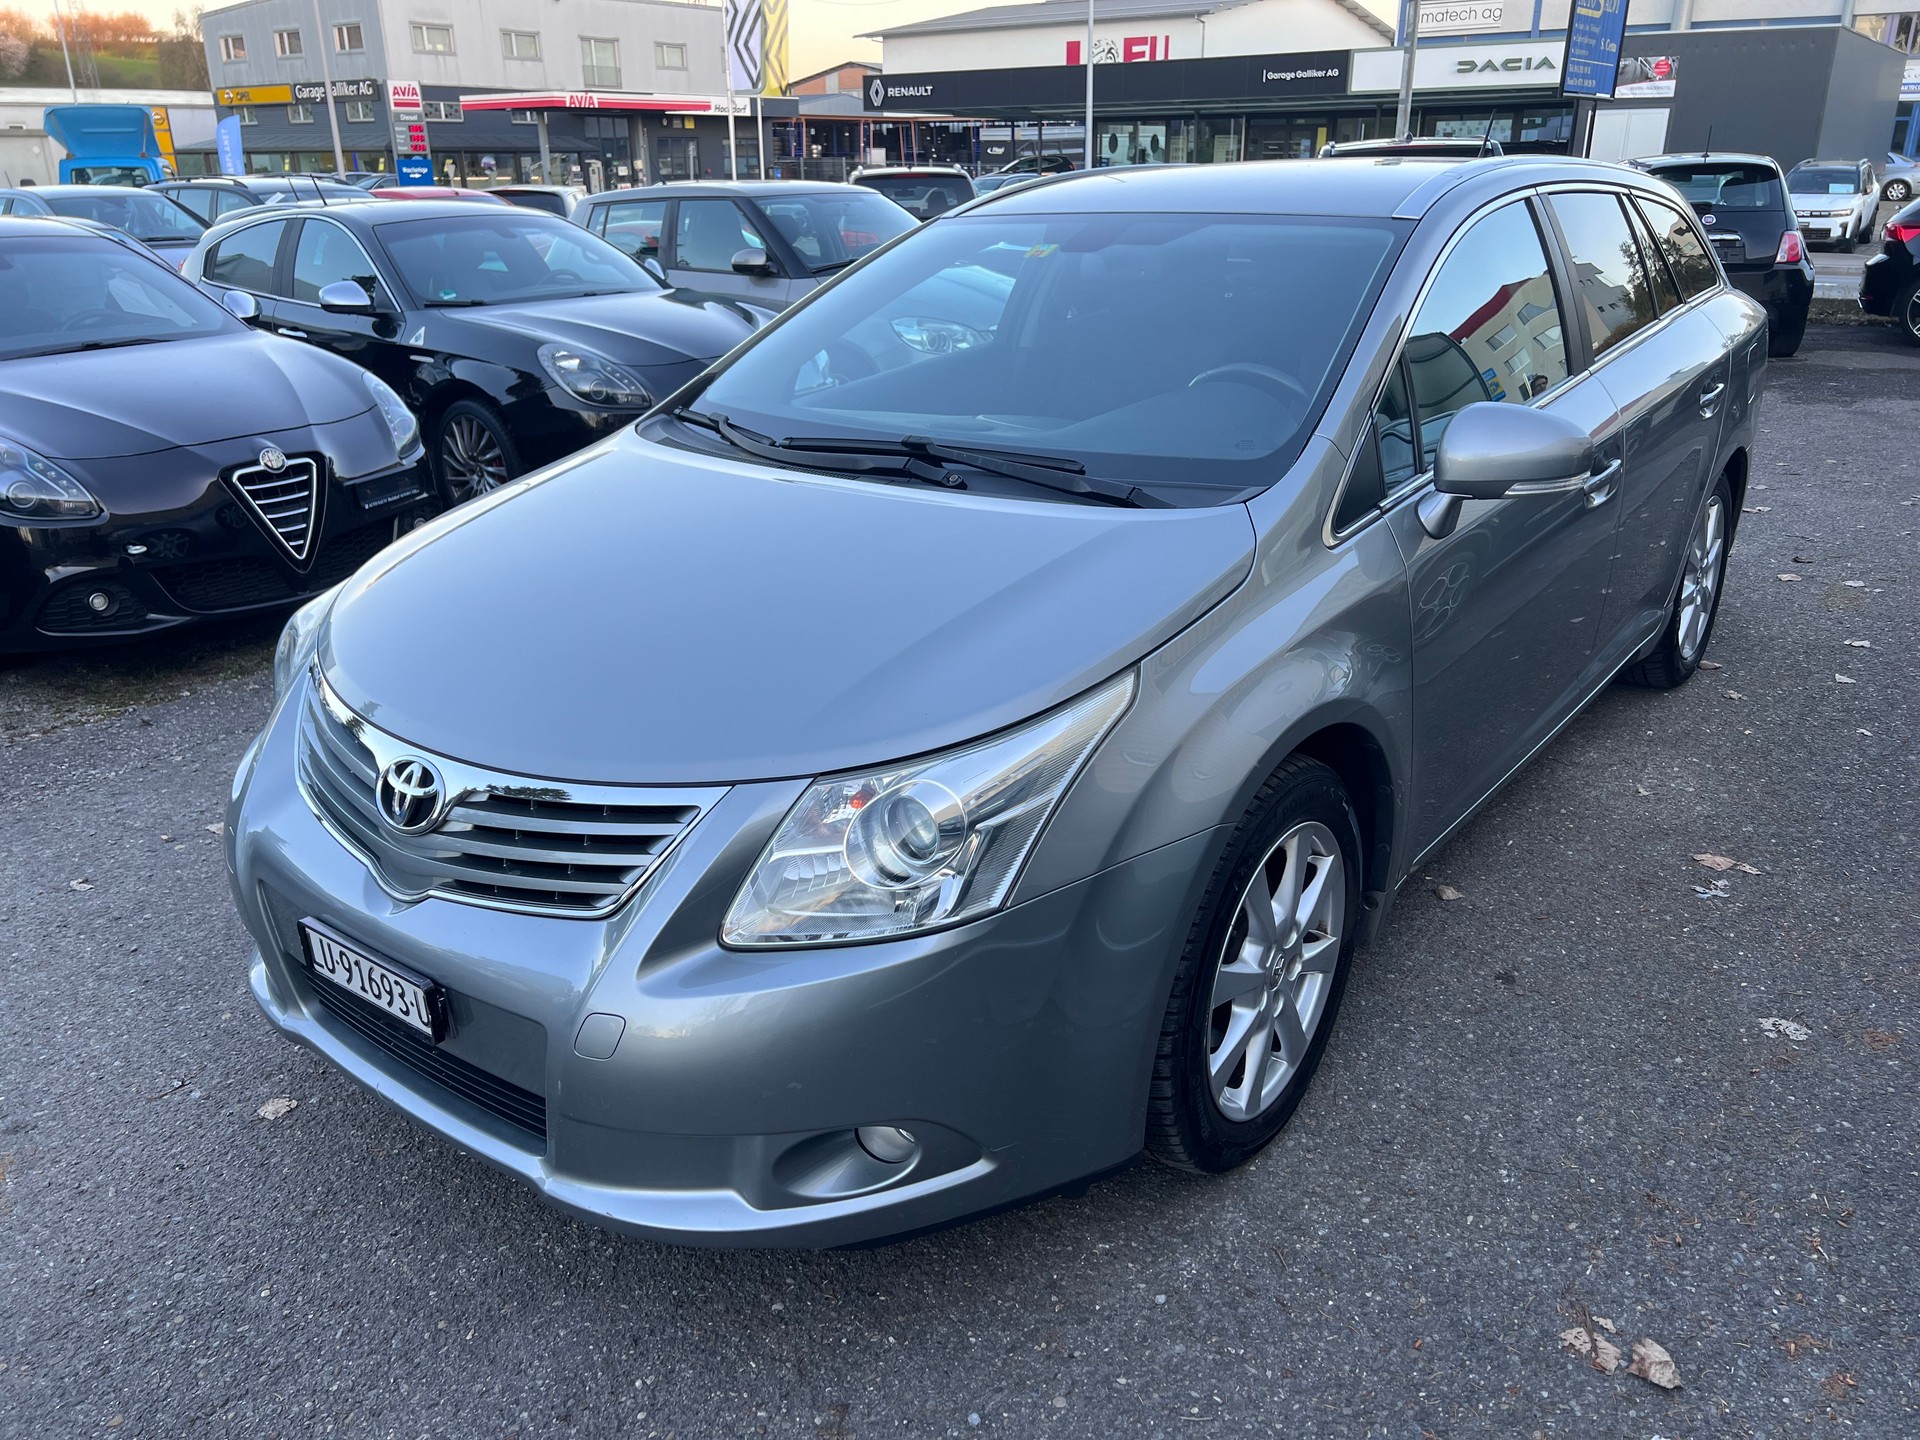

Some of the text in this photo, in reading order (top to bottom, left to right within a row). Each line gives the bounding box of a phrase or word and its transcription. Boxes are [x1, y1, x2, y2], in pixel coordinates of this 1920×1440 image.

[1481, 7, 1503, 22] ag
[1456, 56, 1556, 74] DACIA
[1266, 68, 1339, 81] Garage Galliker AG
[295, 80, 374, 102] Garage alliker AG
[887, 85, 934, 98] RENAULT
[714, 103, 748, 114] Hocdorf
